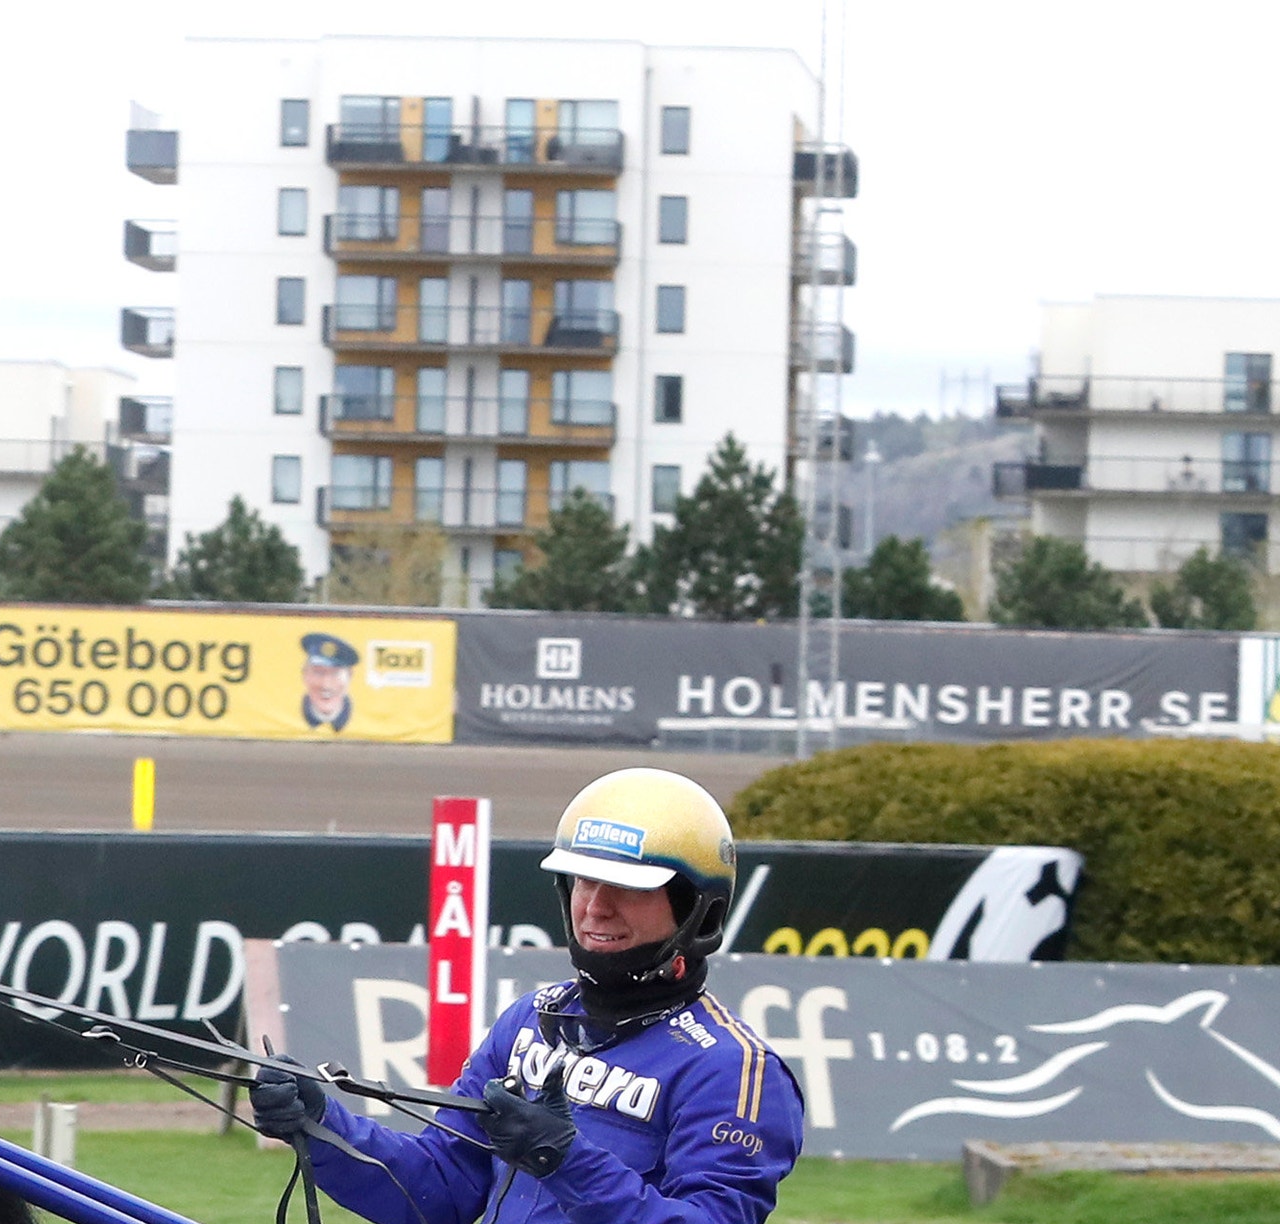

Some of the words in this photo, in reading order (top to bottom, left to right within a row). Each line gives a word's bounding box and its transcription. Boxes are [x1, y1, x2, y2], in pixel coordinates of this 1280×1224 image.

[376, 646, 424, 669] Taxi
[12, 678, 108, 716] 650
[126, 681, 230, 720] 000
[479, 683, 636, 712] HOLMENS
[434, 822, 476, 1003] MÅL
[867, 1031, 1020, 1064] 1.08.2
[711, 1121, 763, 1157] Goop
